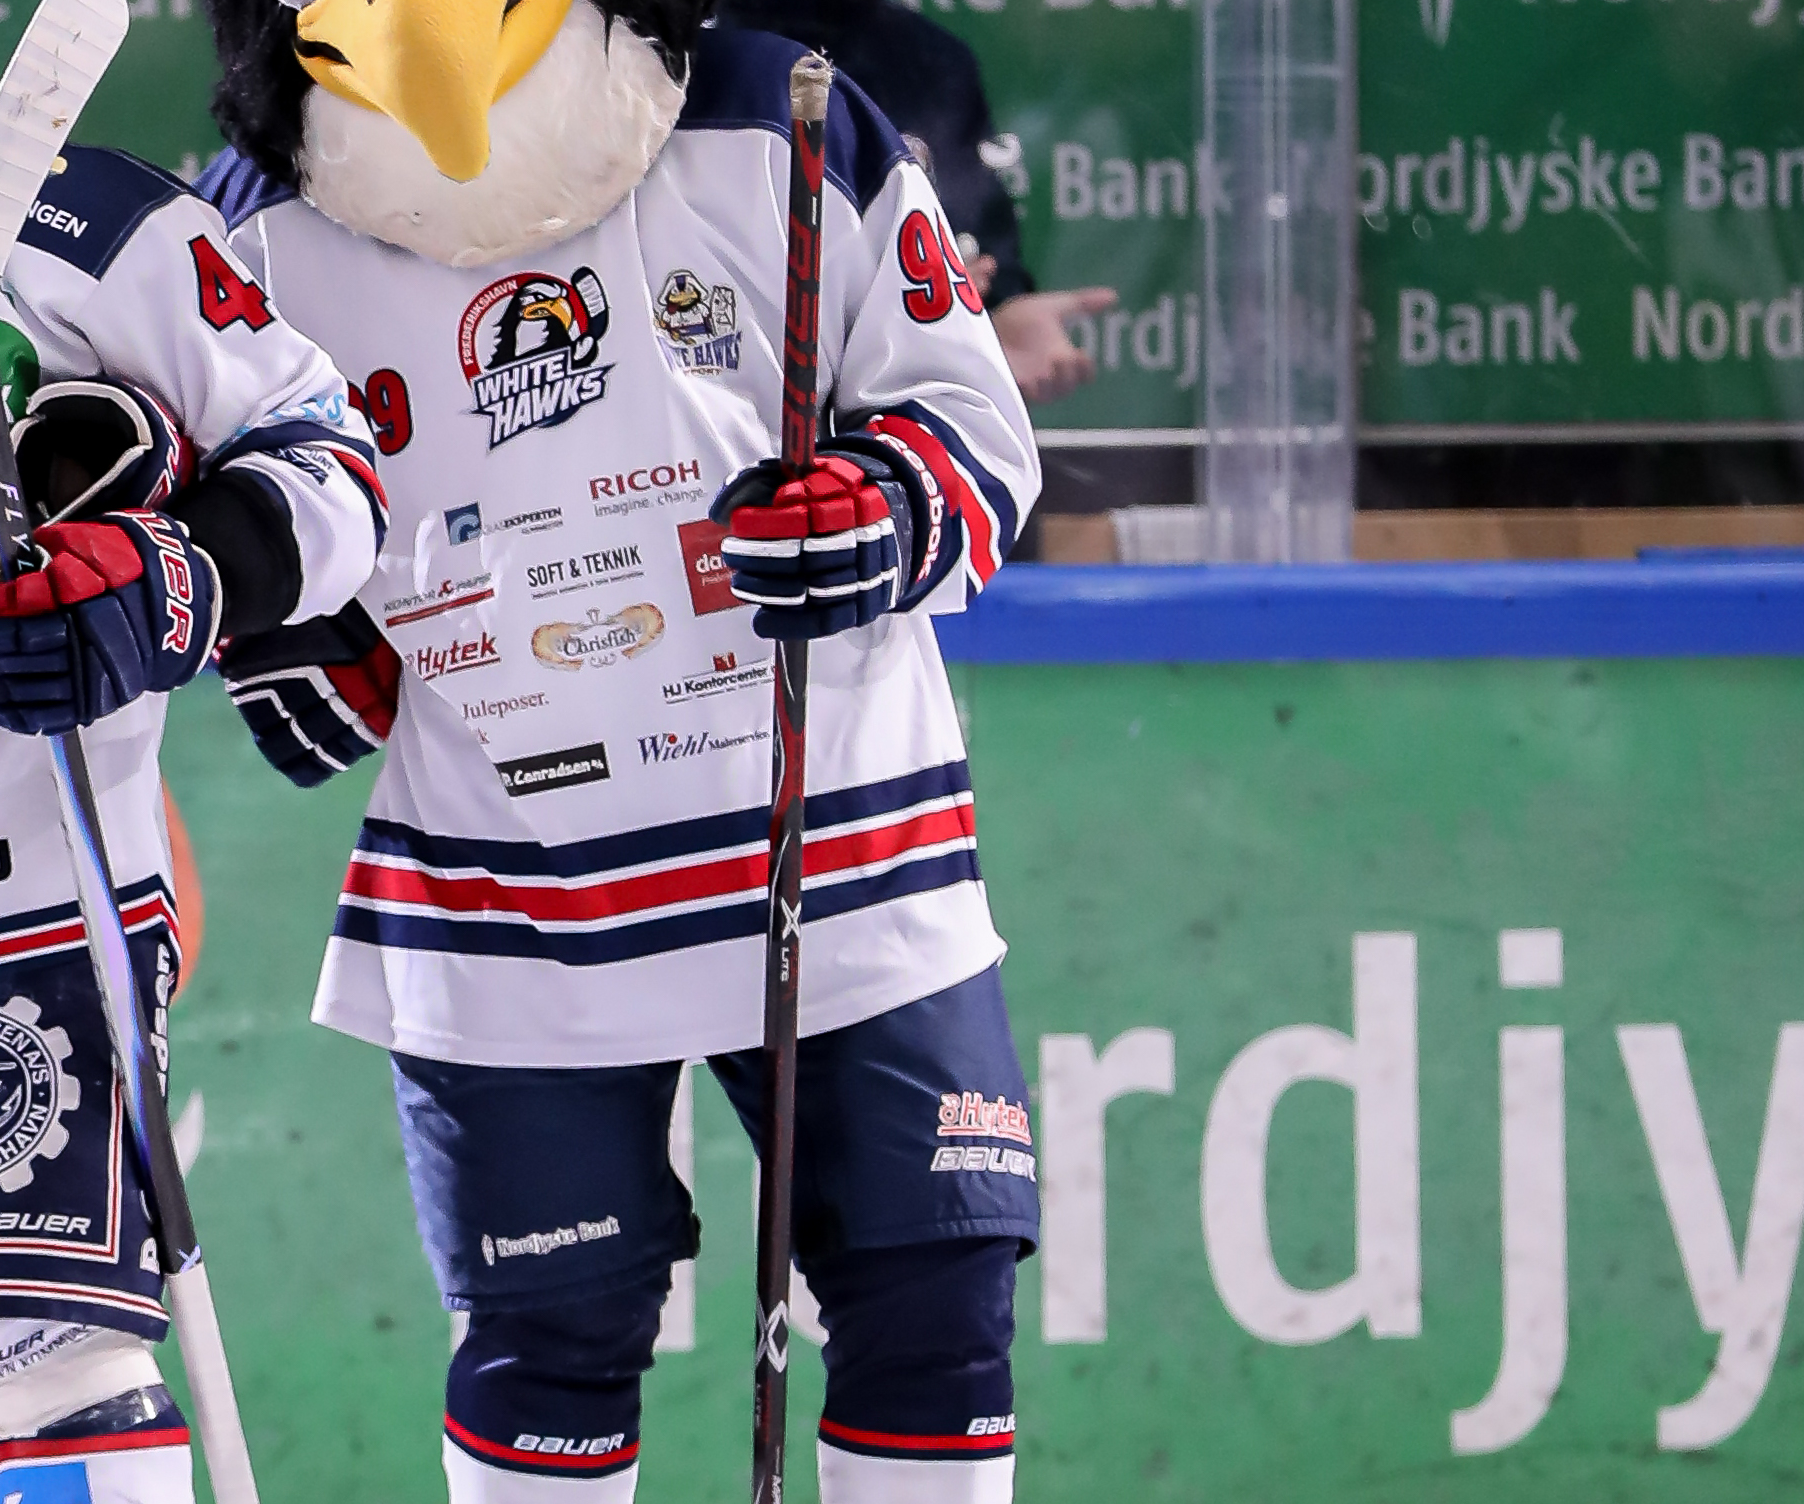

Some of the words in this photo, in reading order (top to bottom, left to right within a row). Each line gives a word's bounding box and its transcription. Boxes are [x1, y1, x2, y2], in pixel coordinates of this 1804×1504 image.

[1398, 287, 1582, 366] Bank
[476, 354, 566, 401] WHITE
[488, 367, 609, 445] HAWKS
[588, 458, 702, 501] RICOH
[527, 561, 565, 588] SOFT
[569, 557, 583, 579] &
[583, 544, 644, 576] TEKNIK
[416, 631, 499, 675] Hytek
[930, 1145, 1037, 1182] BAUER
[513, 1433, 626, 1455] BAUER
